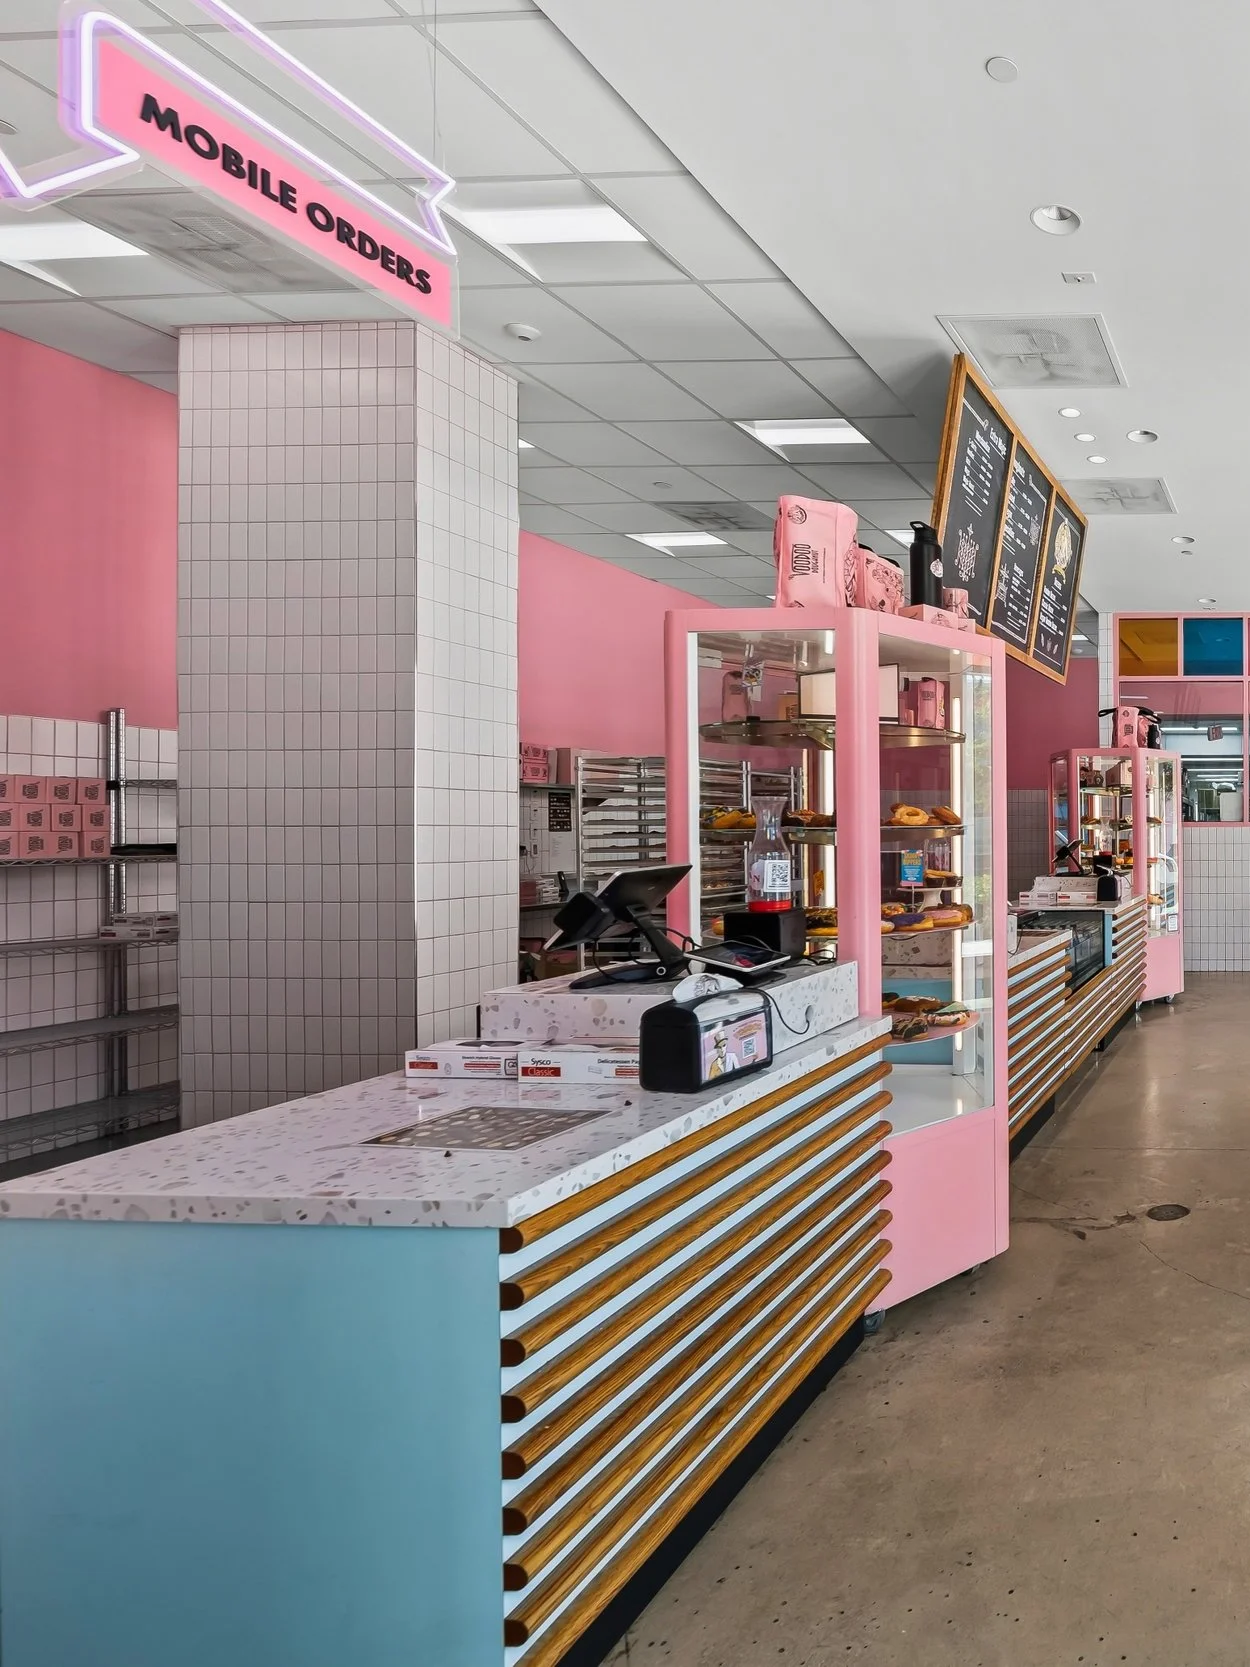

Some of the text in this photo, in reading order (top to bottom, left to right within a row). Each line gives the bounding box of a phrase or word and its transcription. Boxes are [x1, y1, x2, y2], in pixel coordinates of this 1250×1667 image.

[140, 93, 432, 296] MOBILE ORDERS
[788, 543, 811, 580] VOODOO
[527, 1067, 555, 1077] Classic
[531, 1057, 552, 1066] Sysco
